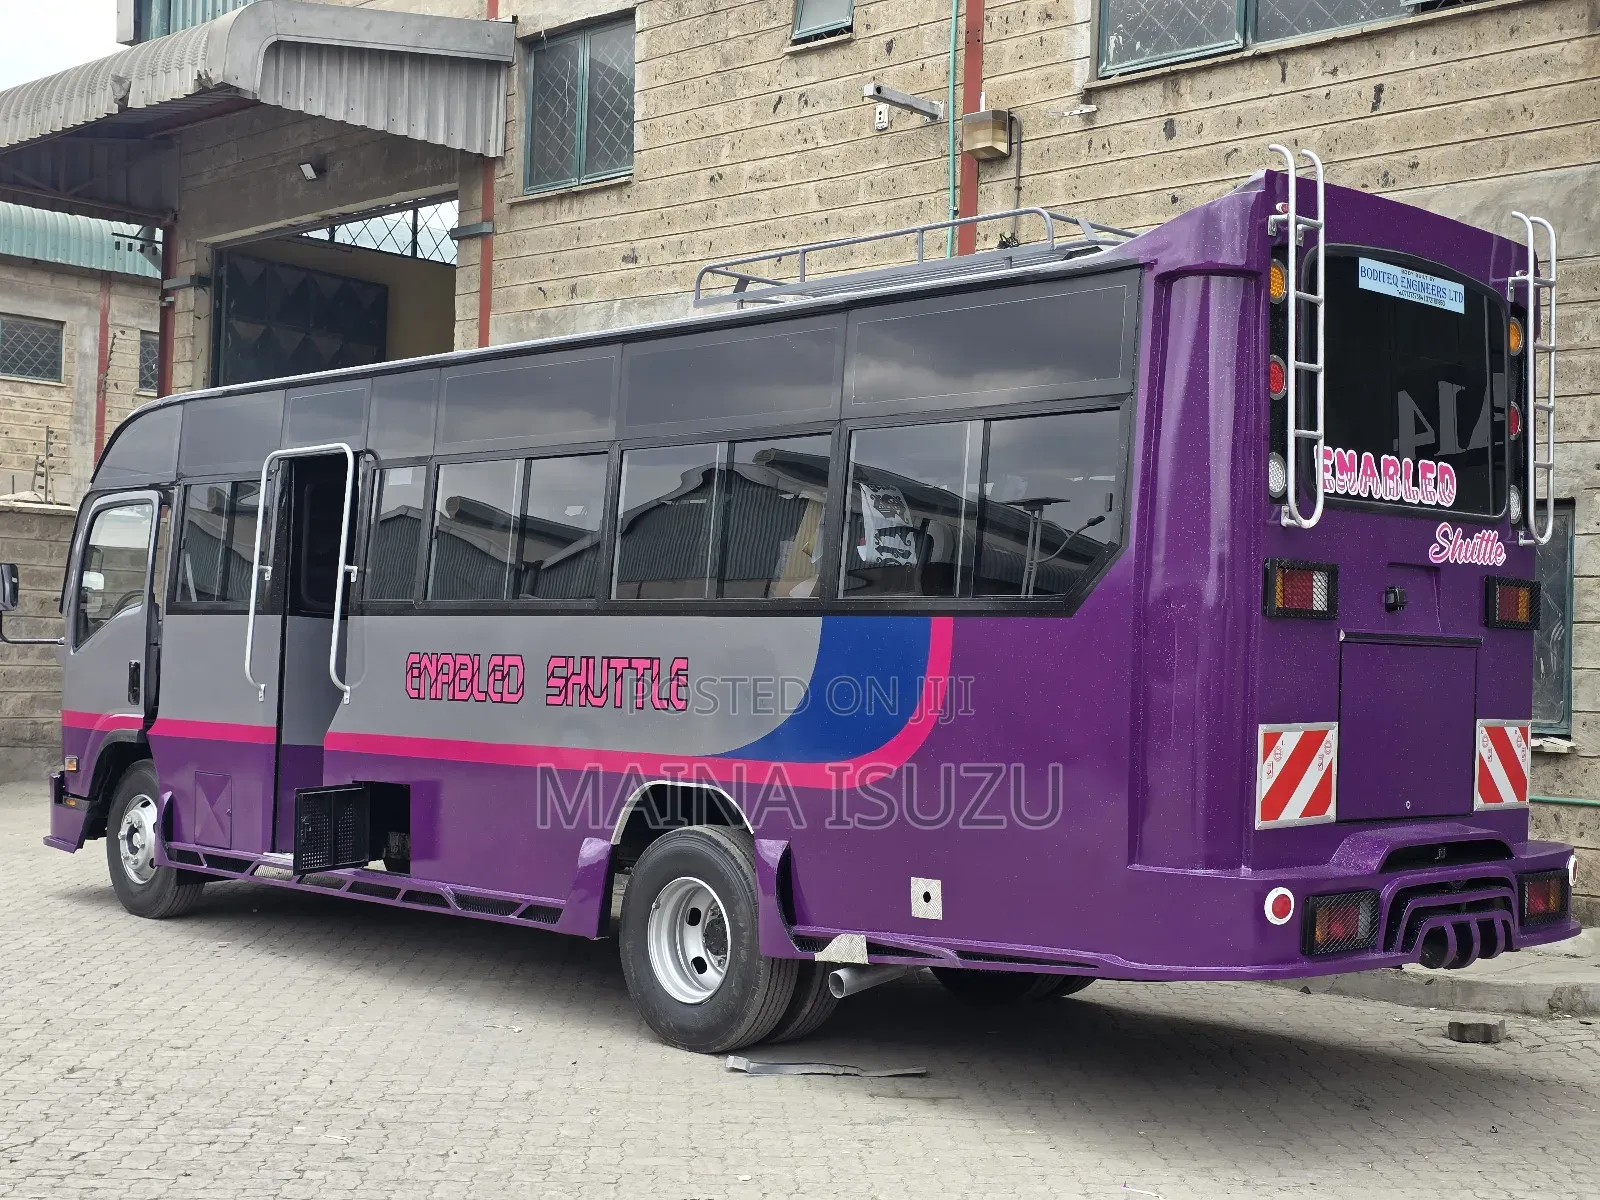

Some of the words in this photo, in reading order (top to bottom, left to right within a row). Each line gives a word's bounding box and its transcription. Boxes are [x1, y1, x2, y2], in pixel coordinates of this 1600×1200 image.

[1360, 265, 1399, 288] BODITEQ
[1400, 275, 1448, 300] ENGINEERS
[1448, 288, 1464, 303] LTD
[1314, 444, 1457, 507] ENABLED
[1429, 522, 1506, 566] Shuttle
[405, 652, 525, 704] ENABLED
[546, 655, 688, 711] SHUTTLE
